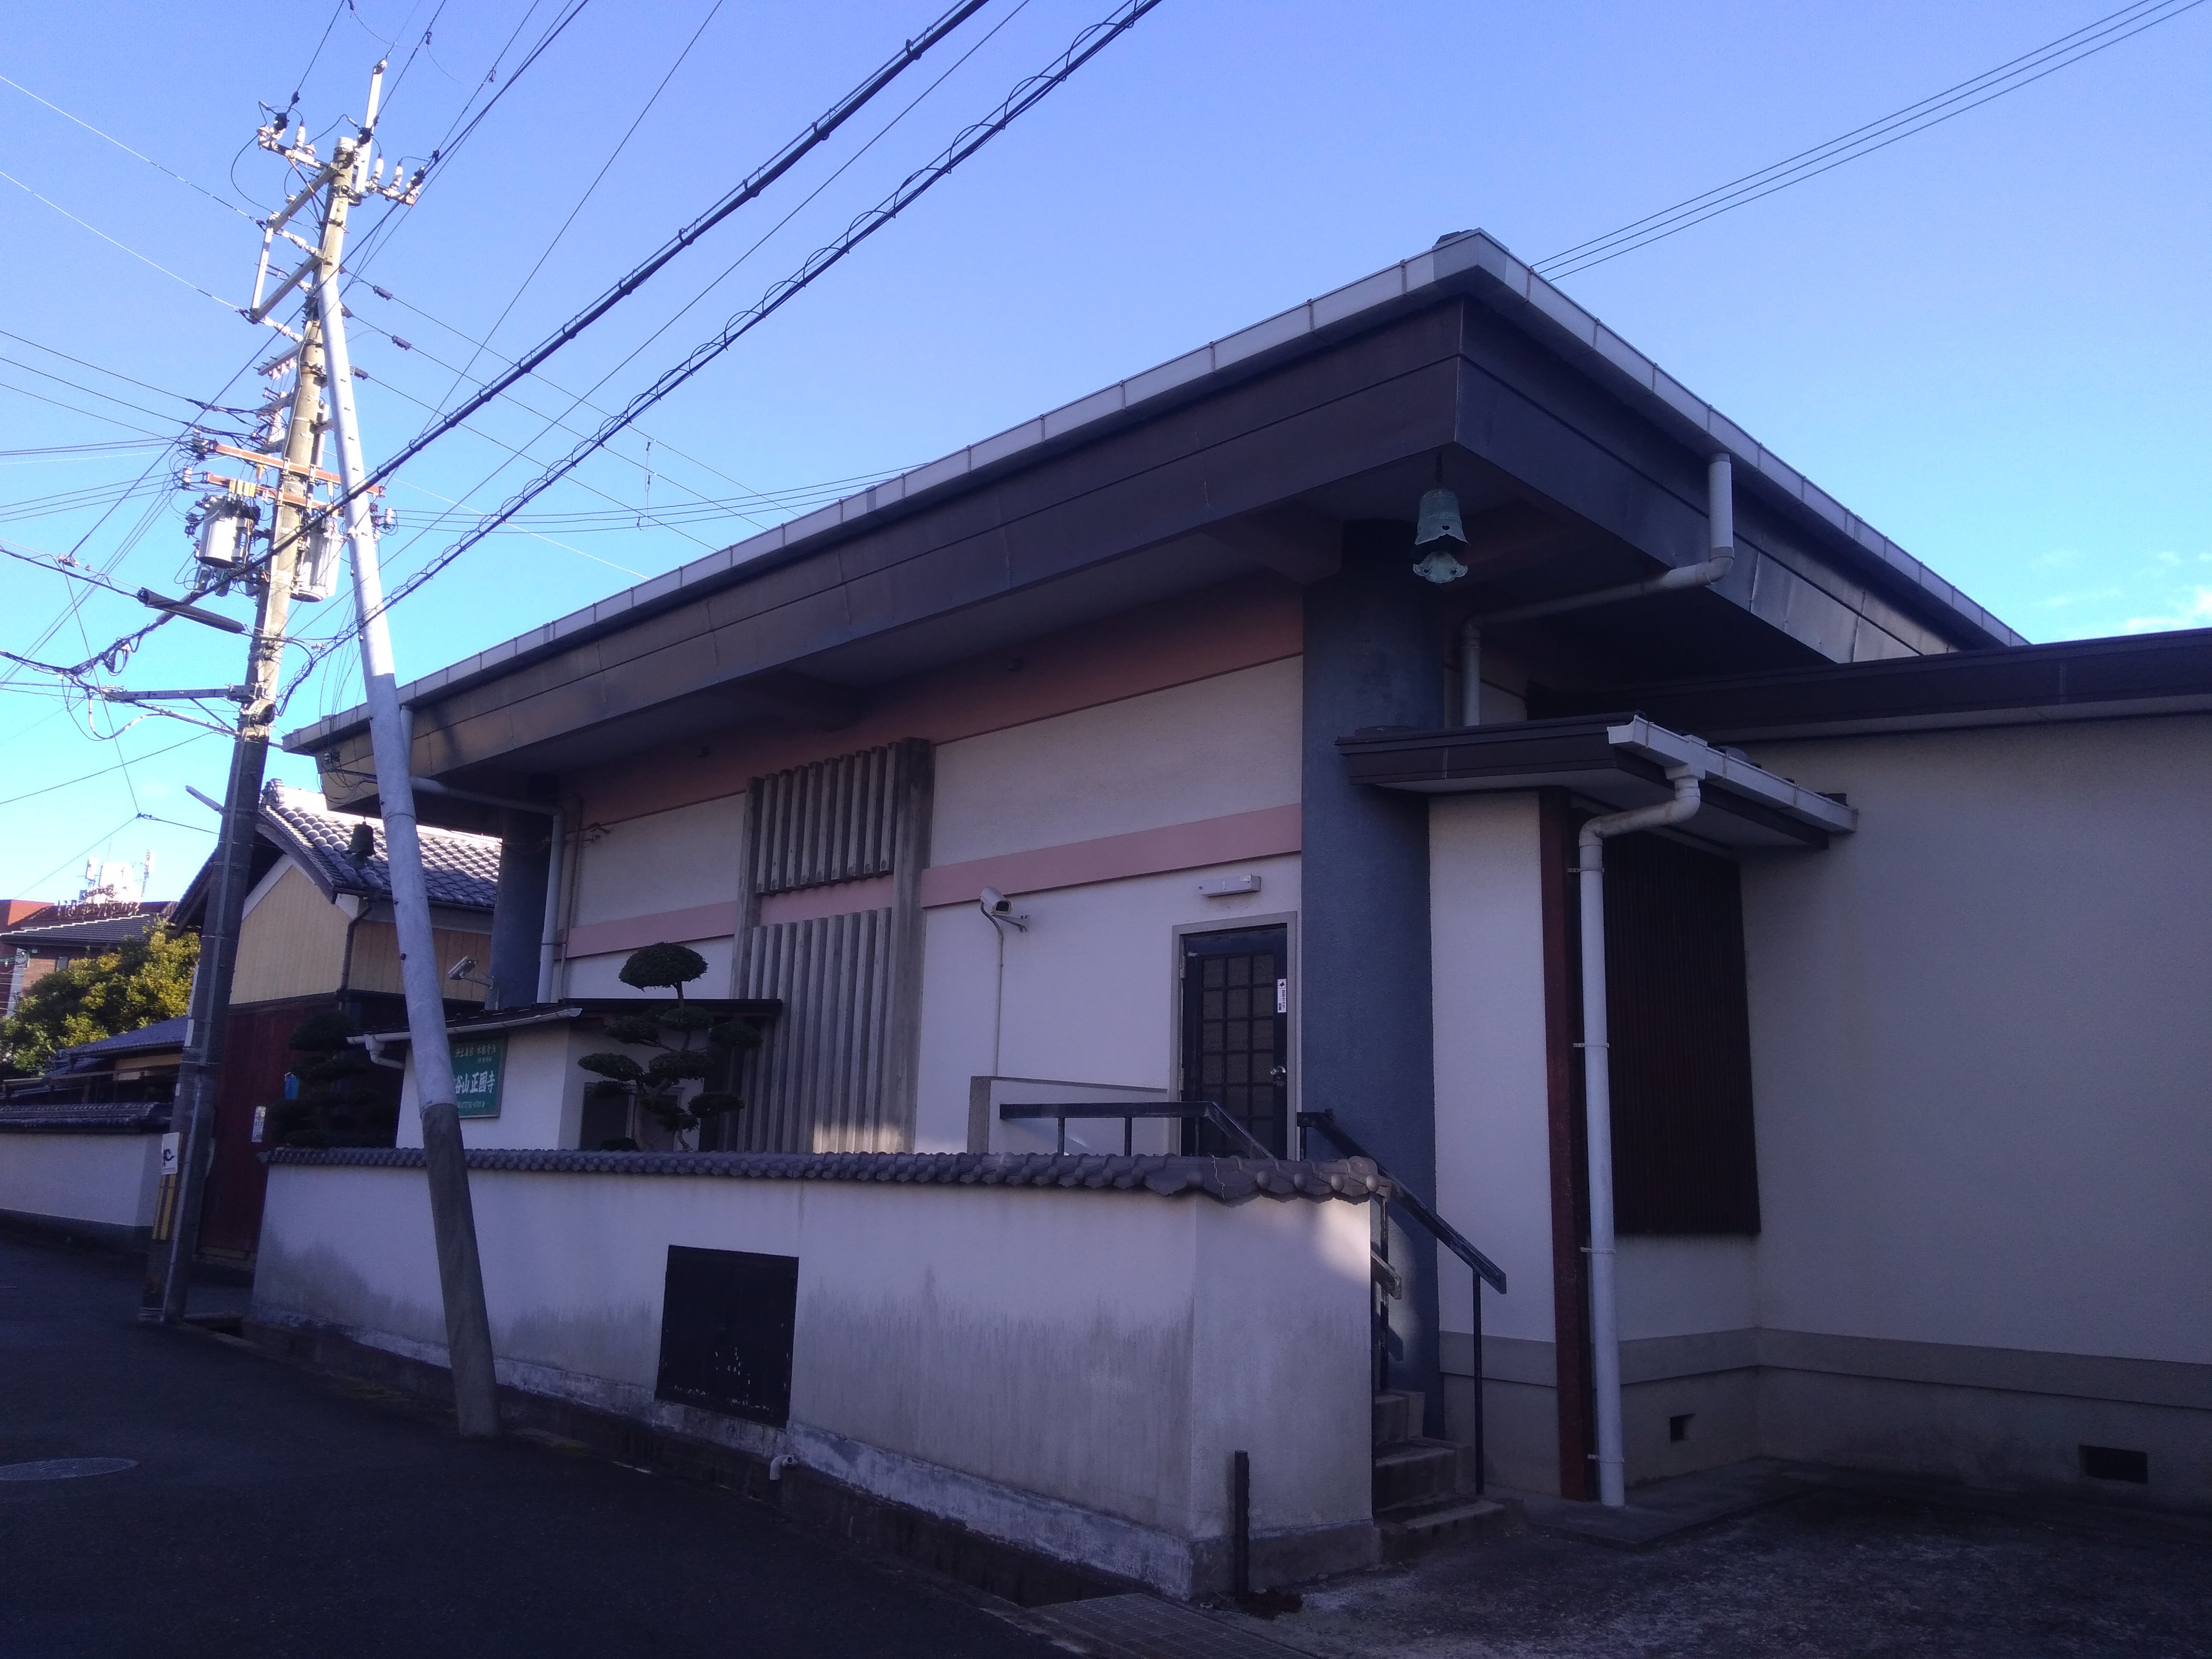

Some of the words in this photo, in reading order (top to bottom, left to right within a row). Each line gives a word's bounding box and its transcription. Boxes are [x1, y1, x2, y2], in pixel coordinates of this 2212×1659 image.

[454, 1070, 495, 1094] 谷山正圓寺
